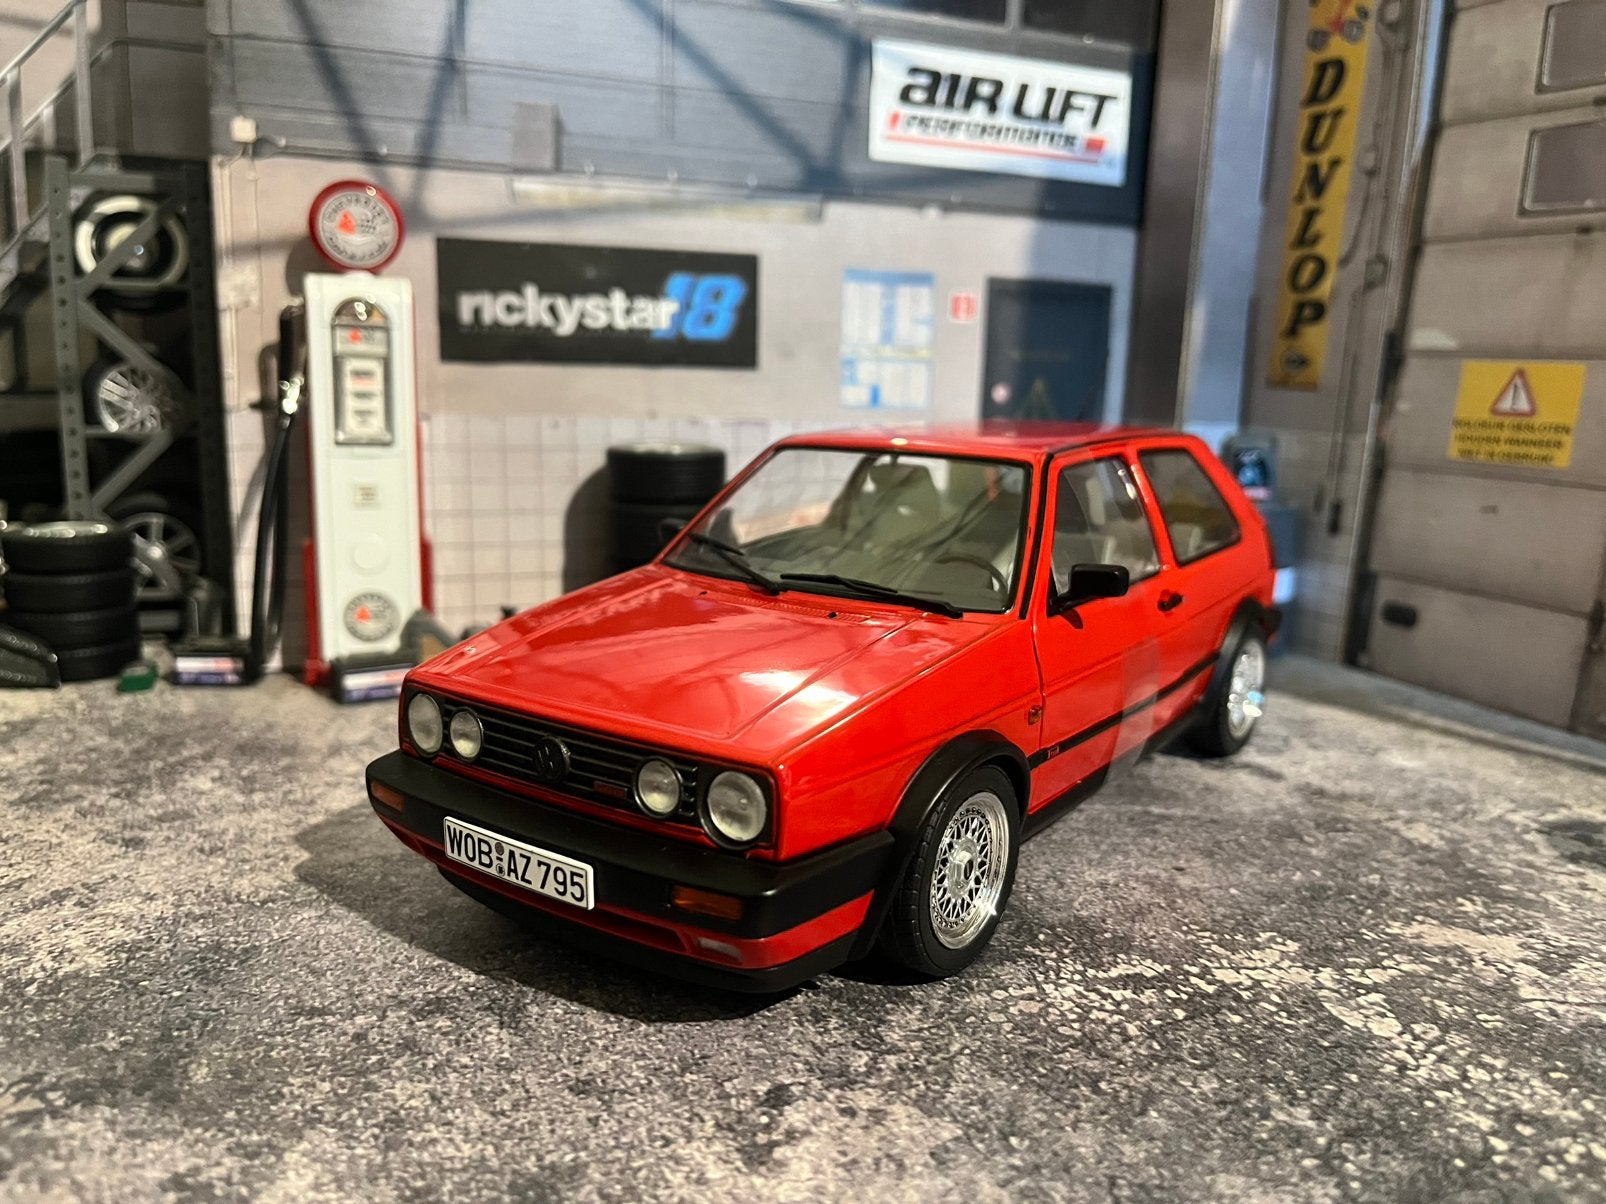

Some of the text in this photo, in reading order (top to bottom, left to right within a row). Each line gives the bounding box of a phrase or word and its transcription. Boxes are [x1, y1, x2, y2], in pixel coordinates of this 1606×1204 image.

[1012, 82, 1119, 130] LIFT
[1281, 58, 1346, 340] DUNLOP
[537, 859, 585, 902] 795
